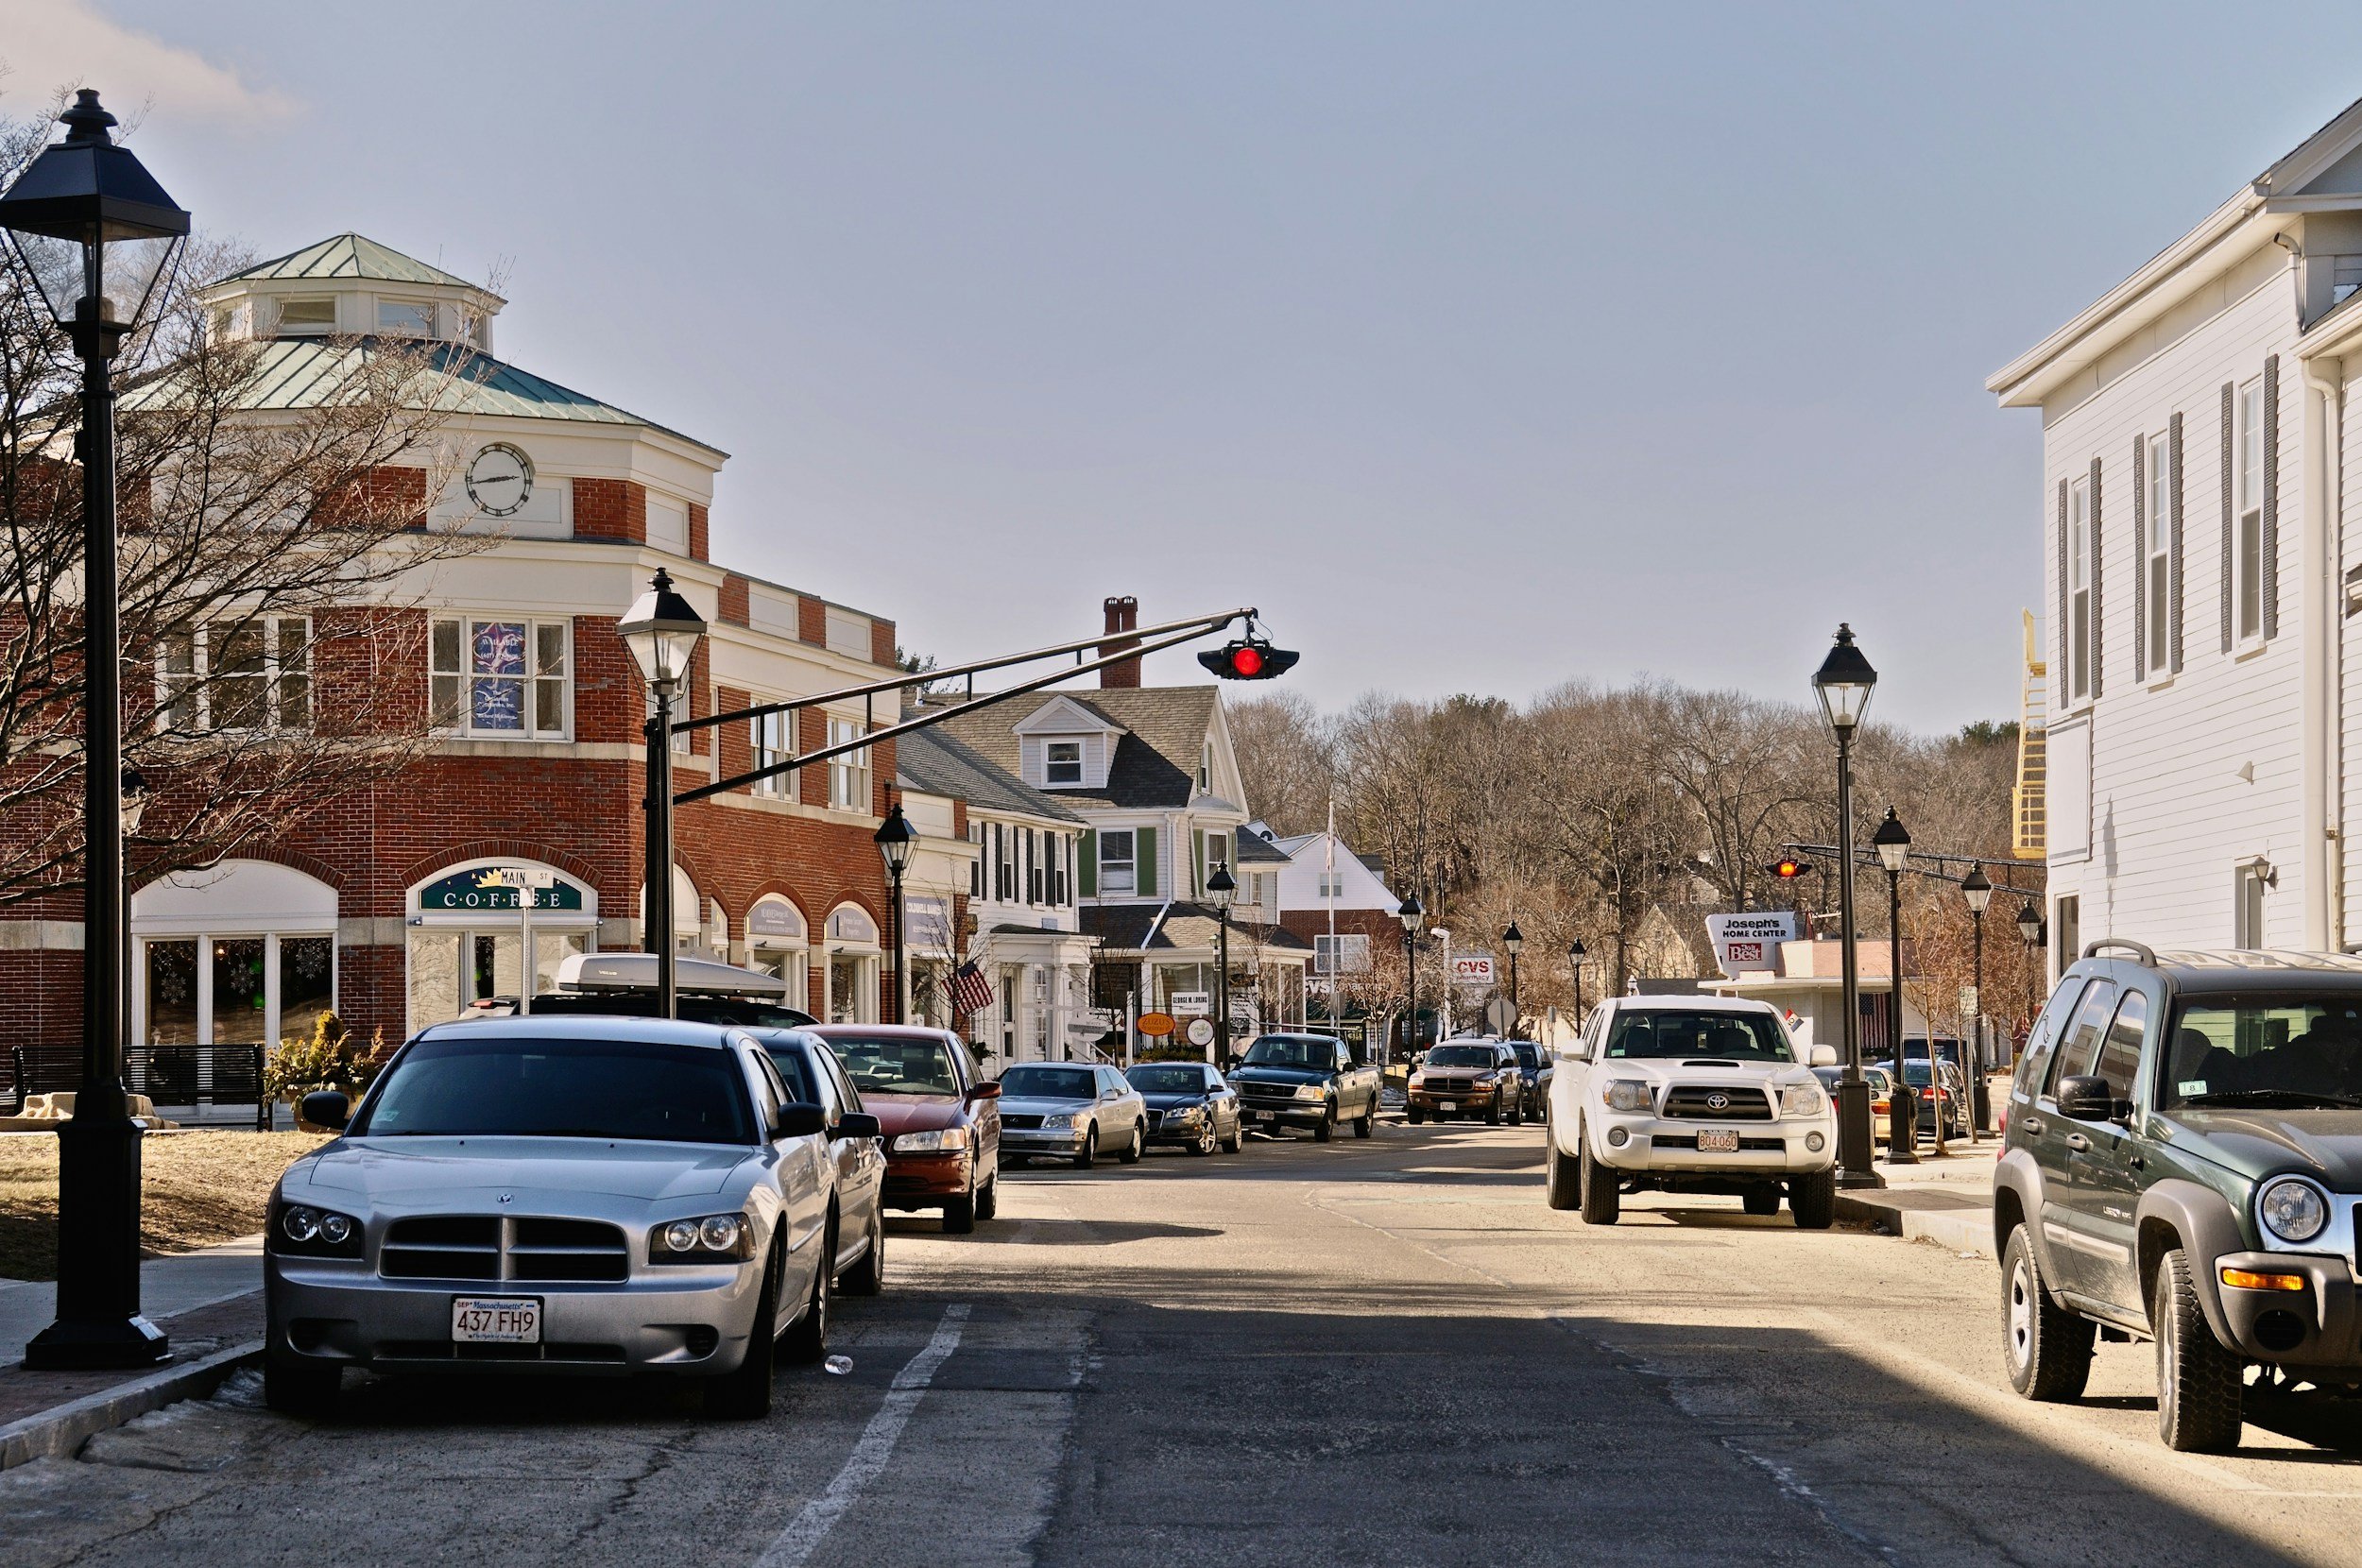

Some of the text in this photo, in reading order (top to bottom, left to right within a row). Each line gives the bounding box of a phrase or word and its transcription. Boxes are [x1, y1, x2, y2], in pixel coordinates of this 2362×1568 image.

[501, 871, 525, 884] MAIN
[1725, 919, 1780, 929] Joseph's
[1752, 929, 1787, 938] CENTER
[1730, 946, 1761, 961] Best
[1457, 961, 1489, 973] CVS
[472, 1301, 521, 1309] Massachusetts
[457, 1311, 534, 1332] 437 FH9
